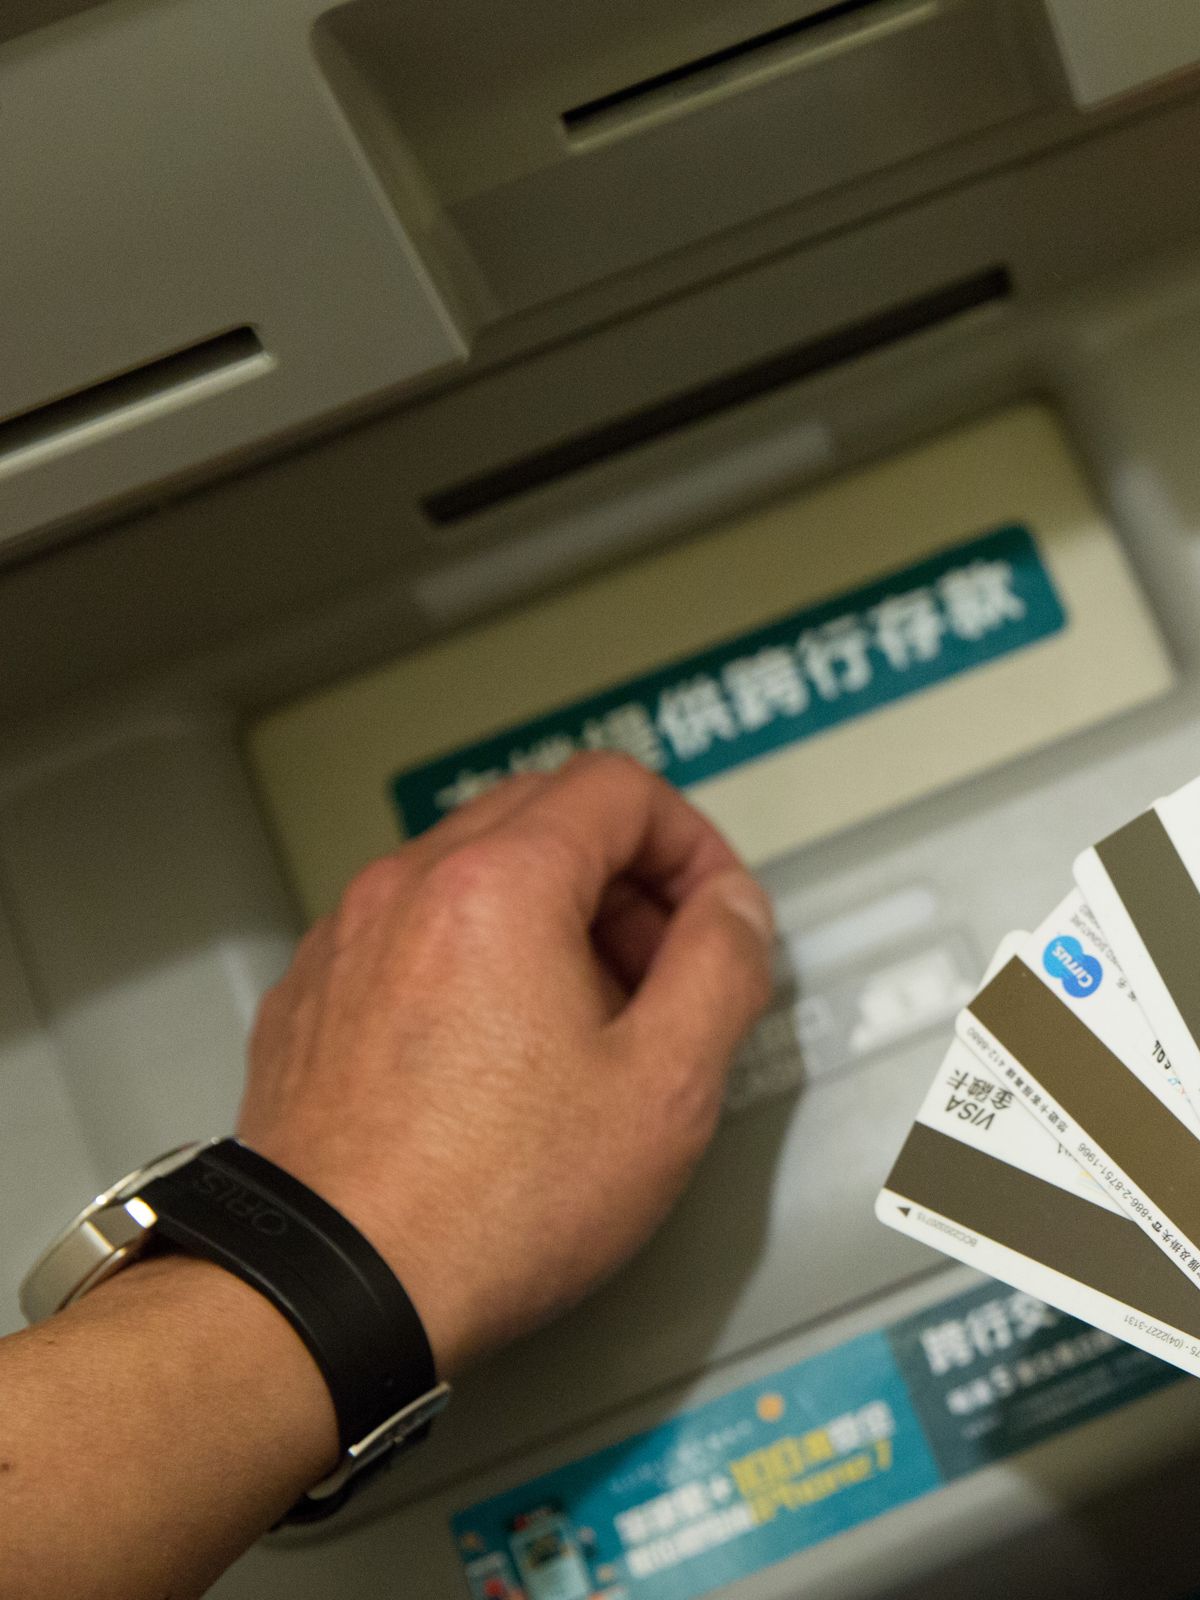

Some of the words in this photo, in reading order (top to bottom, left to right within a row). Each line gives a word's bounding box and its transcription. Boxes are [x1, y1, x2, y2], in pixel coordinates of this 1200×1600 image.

[1046, 941, 1095, 991] Cirrus
[943, 1065, 1016, 1114] 金融卡
[943, 1092, 997, 1132] VISA
[1076, 1141, 1155, 1223] +886-2-8751-1966
